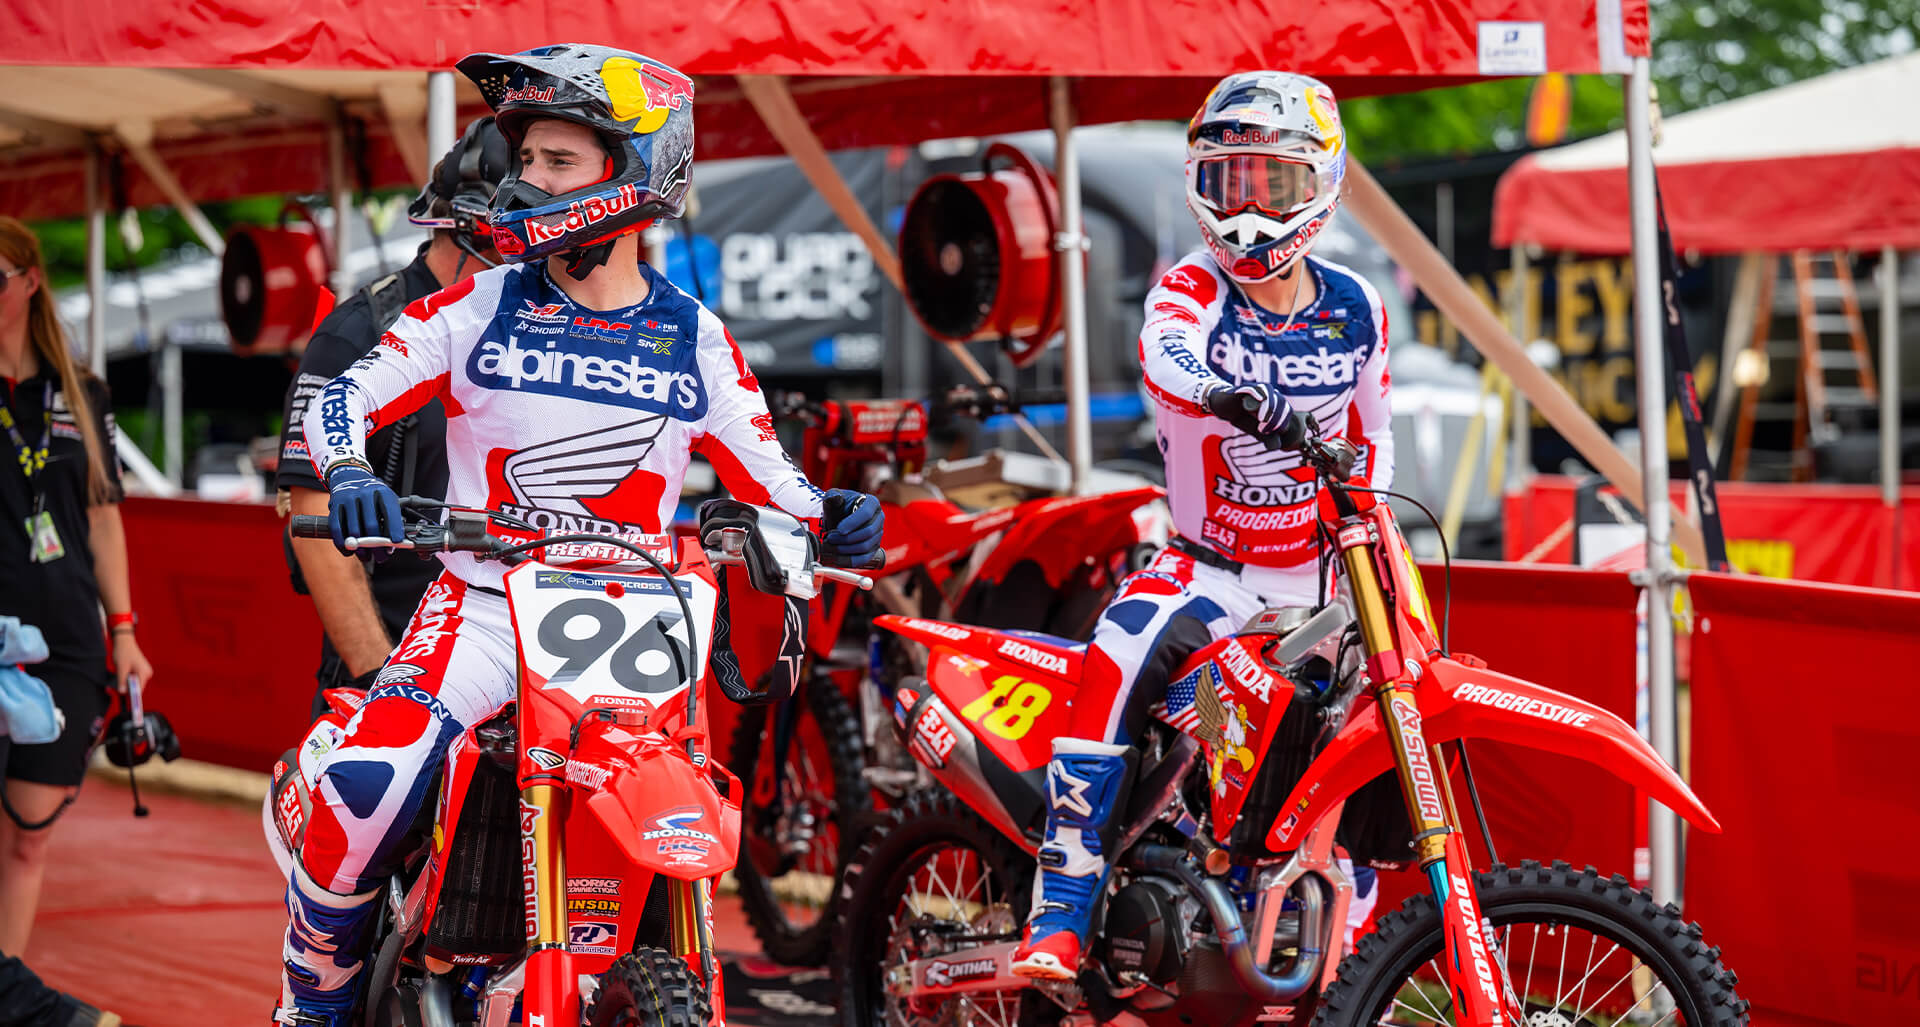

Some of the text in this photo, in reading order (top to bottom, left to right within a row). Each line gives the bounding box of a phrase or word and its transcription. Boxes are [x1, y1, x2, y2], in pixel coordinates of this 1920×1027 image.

[504, 86, 556, 104] Red Bull
[1223, 130, 1279, 144] Red Bull
[525, 184, 639, 246] Red Bull
[1268, 225, 1306, 270] Red
[528, 325, 565, 334] SHOWA
[570, 317, 632, 338] HRC
[477, 336, 698, 410] alpinestars
[1211, 332, 1368, 388] alpinestars
[1214, 476, 1316, 506] HOND
[537, 598, 697, 694] 96
[998, 639, 1068, 675] HONDA
[1218, 638, 1274, 705] HONDA
[594, 696, 647, 707] HONDA
[960, 675, 1052, 741] 18
[1452, 682, 1594, 728] PROGRESSIVE
[1404, 734, 1443, 821] SHOWA
[642, 828, 719, 844] HONDA
[568, 899, 621, 912] INSON
[1450, 873, 1500, 1004] DUNLOP
[452, 954, 491, 965] Twin Air
